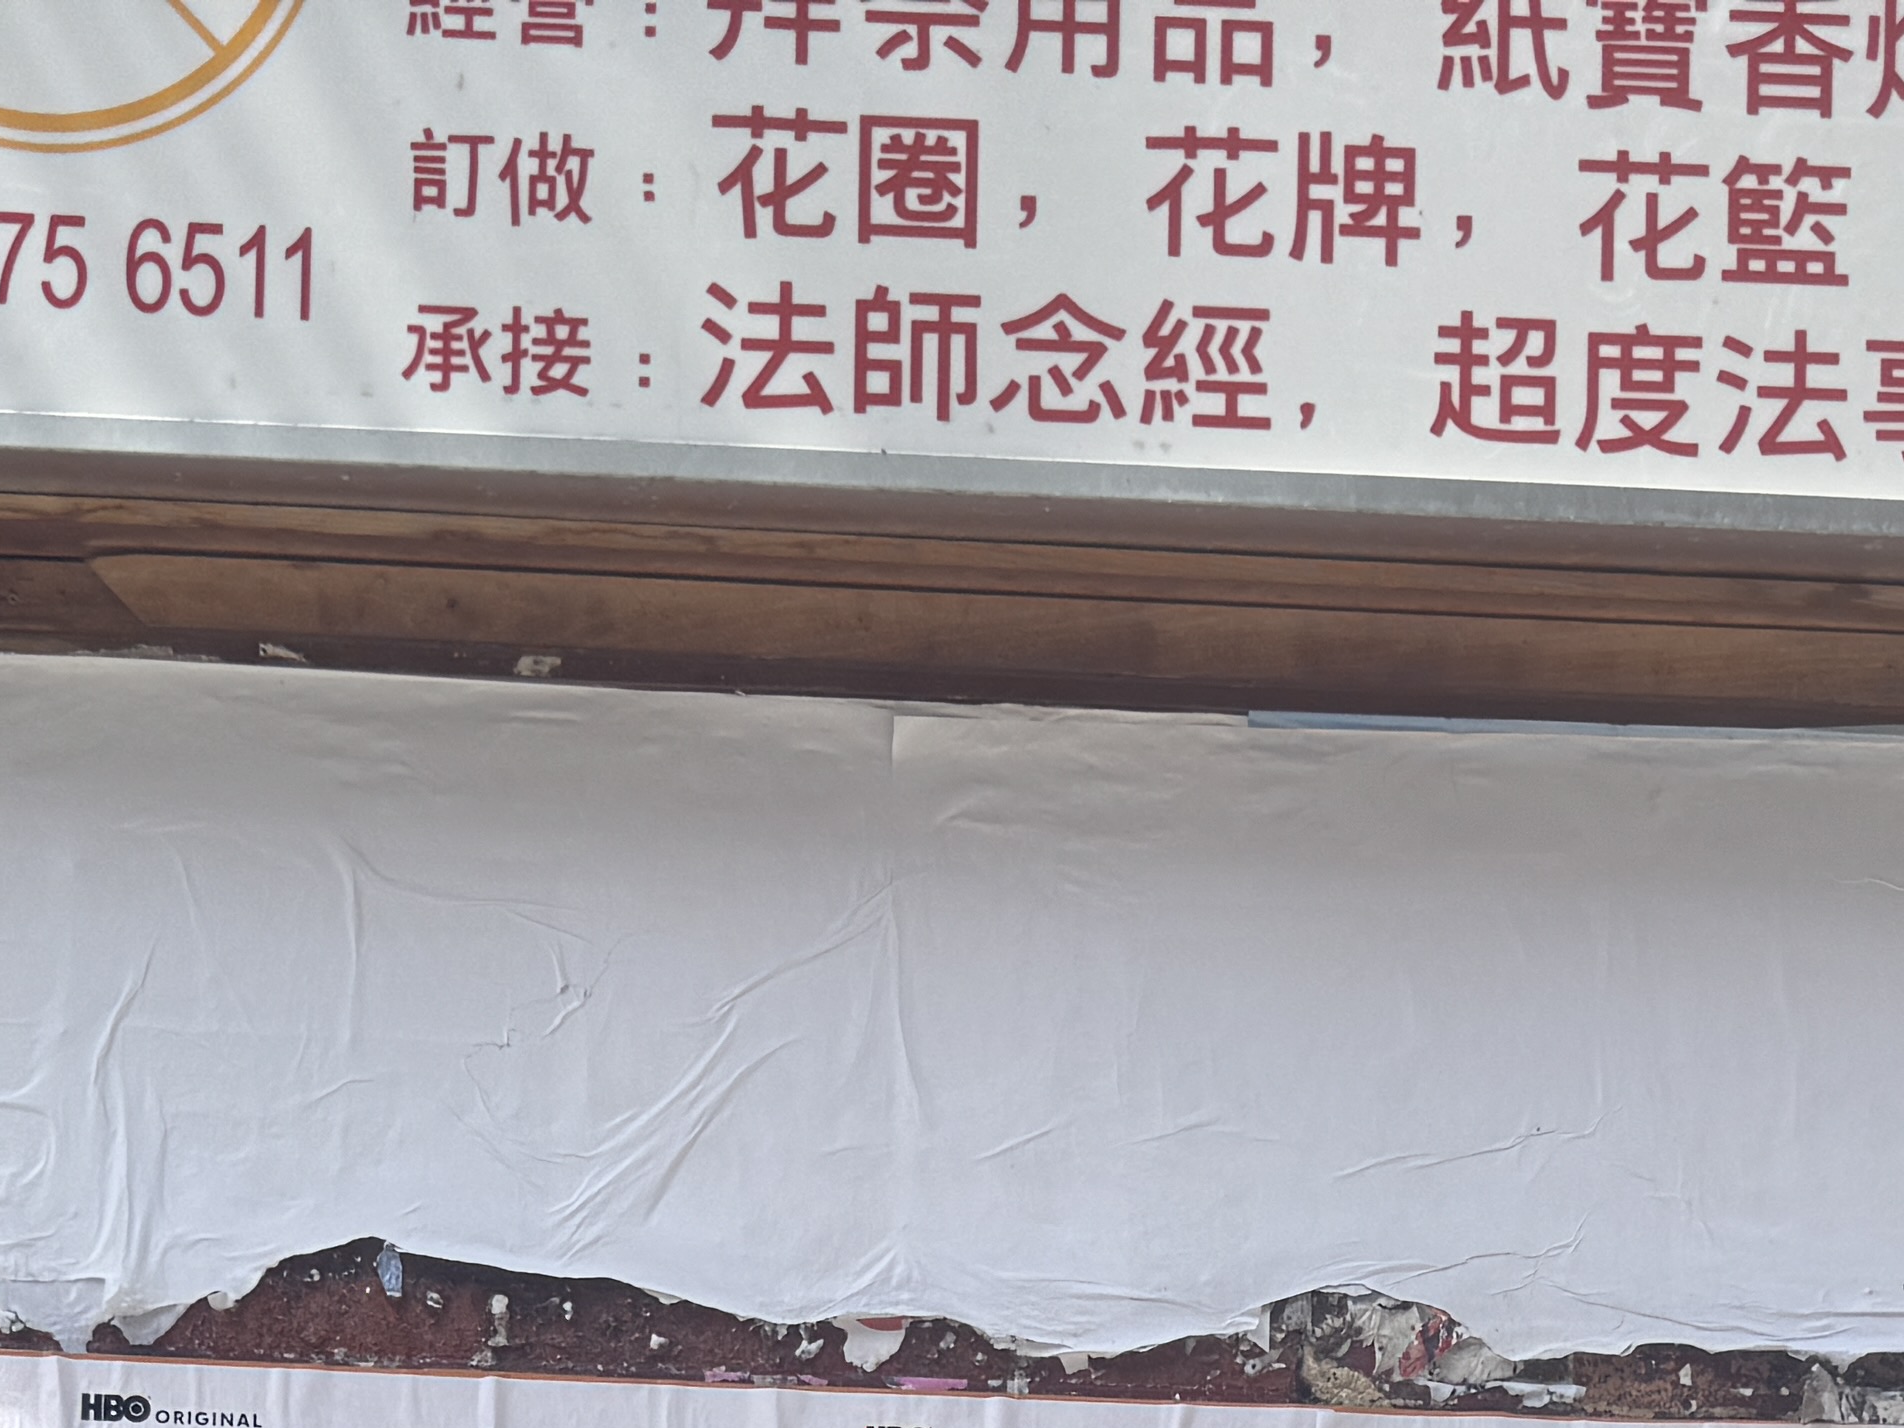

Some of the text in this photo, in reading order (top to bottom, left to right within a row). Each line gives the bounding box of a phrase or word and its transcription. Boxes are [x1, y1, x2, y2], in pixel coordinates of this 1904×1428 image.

[125, 217, 313, 321] 6511
[81, 1393, 262, 1428] HBO ORIGINAL
